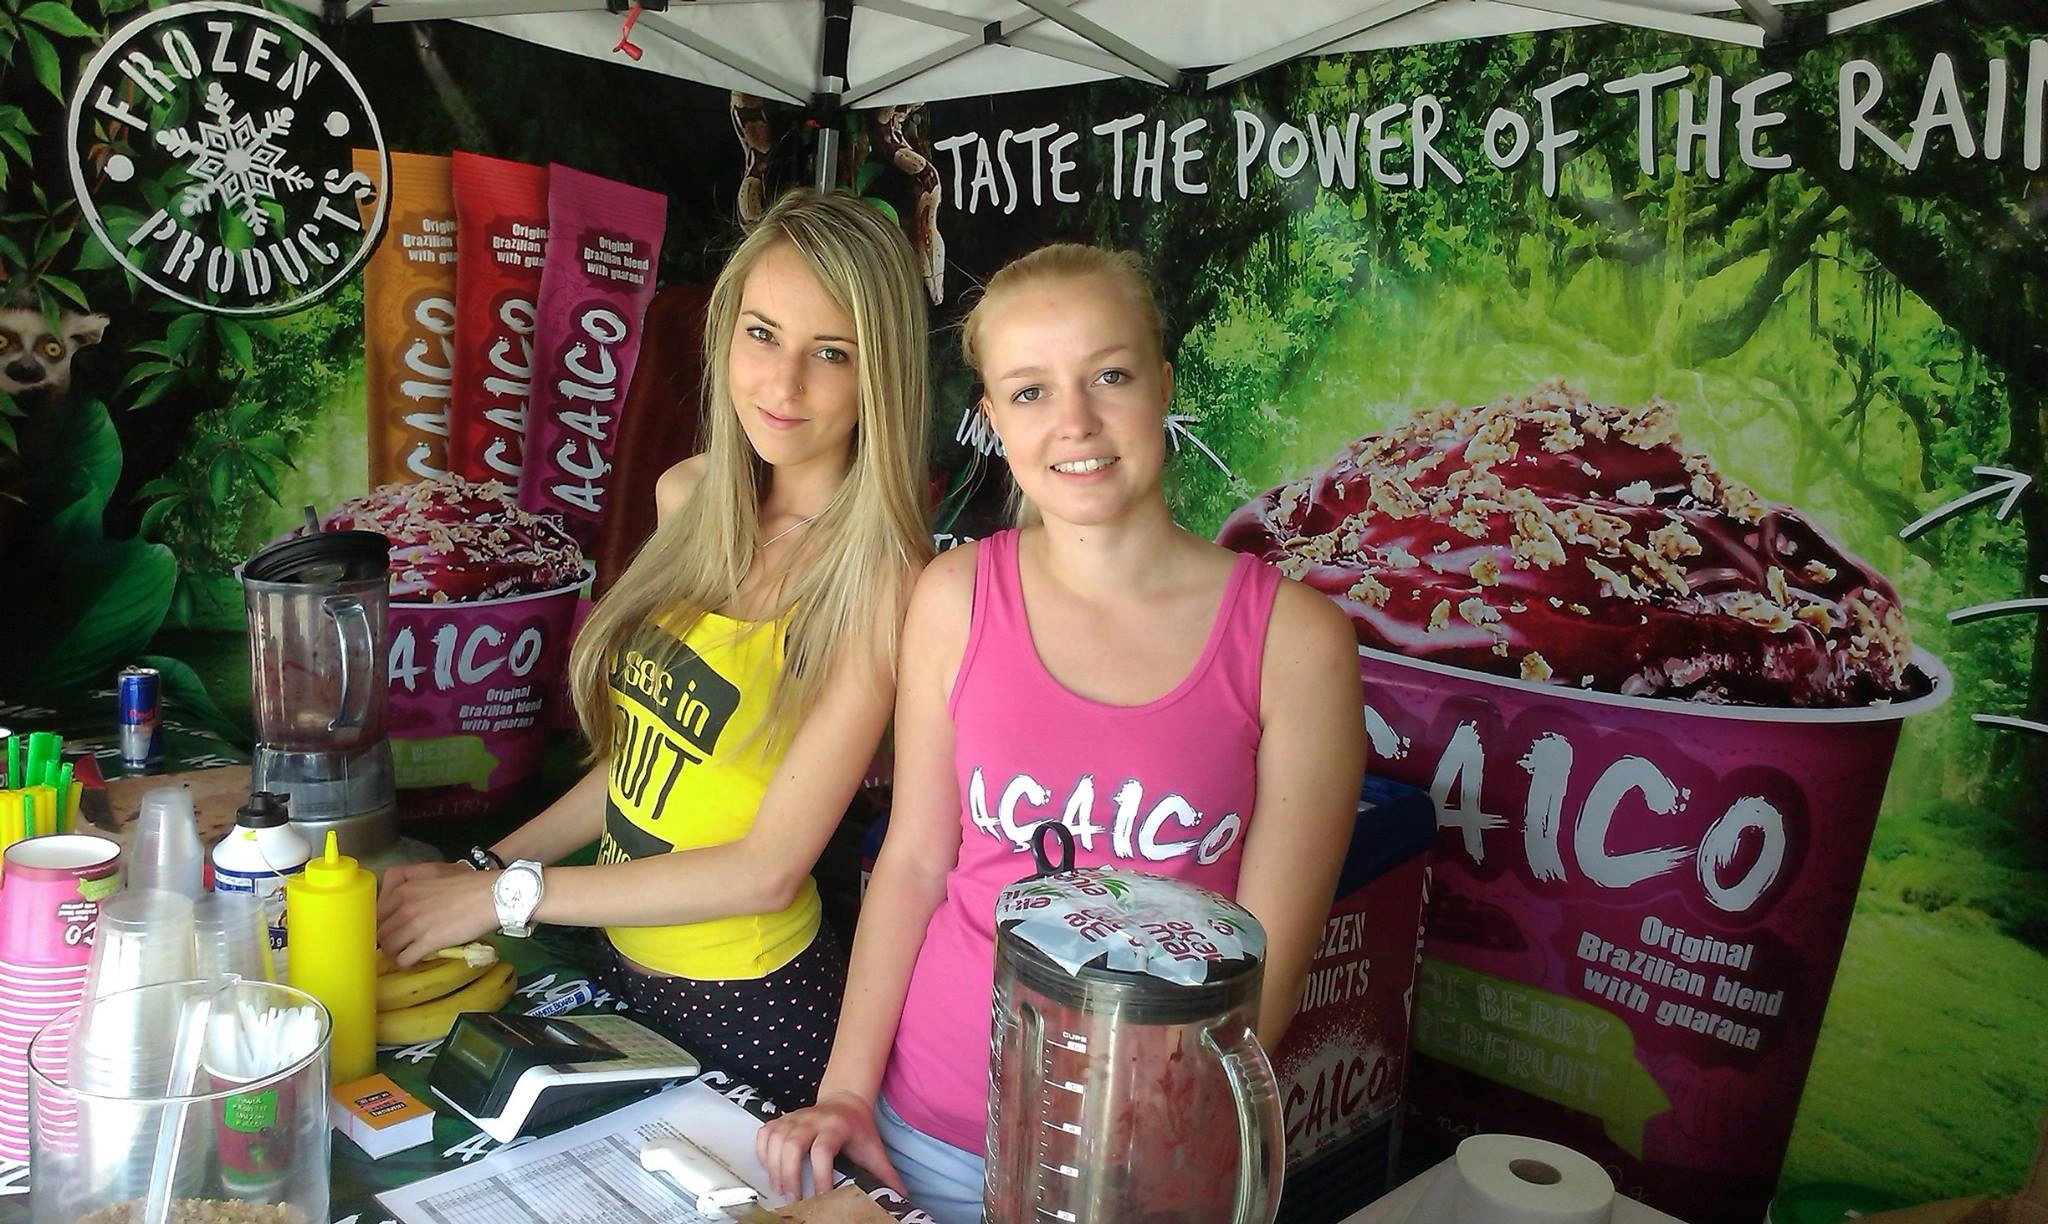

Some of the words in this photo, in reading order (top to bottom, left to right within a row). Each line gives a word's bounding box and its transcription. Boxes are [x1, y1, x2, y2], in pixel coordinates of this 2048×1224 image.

[94, 21, 321, 132] FROZEN
[934, 122, 1080, 215] TASTE
[1093, 113, 1207, 202] THE
[1232, 94, 1464, 199] POWER
[1482, 73, 1590, 198] OF
[1603, 66, 1793, 179] THE
[127, 168, 373, 296] PRODUCTS
[403, 234, 453, 249] Brazilian
[422, 218, 457, 233] Origin
[493, 236, 541, 253] Brazilian
[512, 224, 548, 240] Origin
[599, 236, 634, 253] Original
[408, 249, 436, 263] with
[496, 251, 521, 267] with
[389, 624, 542, 692] AICO
[459, 704, 513, 719] Brazilian
[487, 685, 531, 702] Original
[675, 679, 711, 738] in
[461, 718, 490, 731] with
[611, 704, 703, 820] RUIT
[1363, 704, 1786, 912] AICO
[1314, 911, 1366, 960] ZEN
[1640, 915, 1754, 971] Original
[1297, 958, 1371, 1015] DUCTS
[1576, 931, 1706, 998] Brazilian
[1712, 975, 1784, 1017] blend
[1476, 983, 1610, 1055] BERRY
[1583, 968, 1650, 1014] with
[1655, 1000, 1761, 1051] guarana
[1416, 1006, 1607, 1101] PERFRUIT
